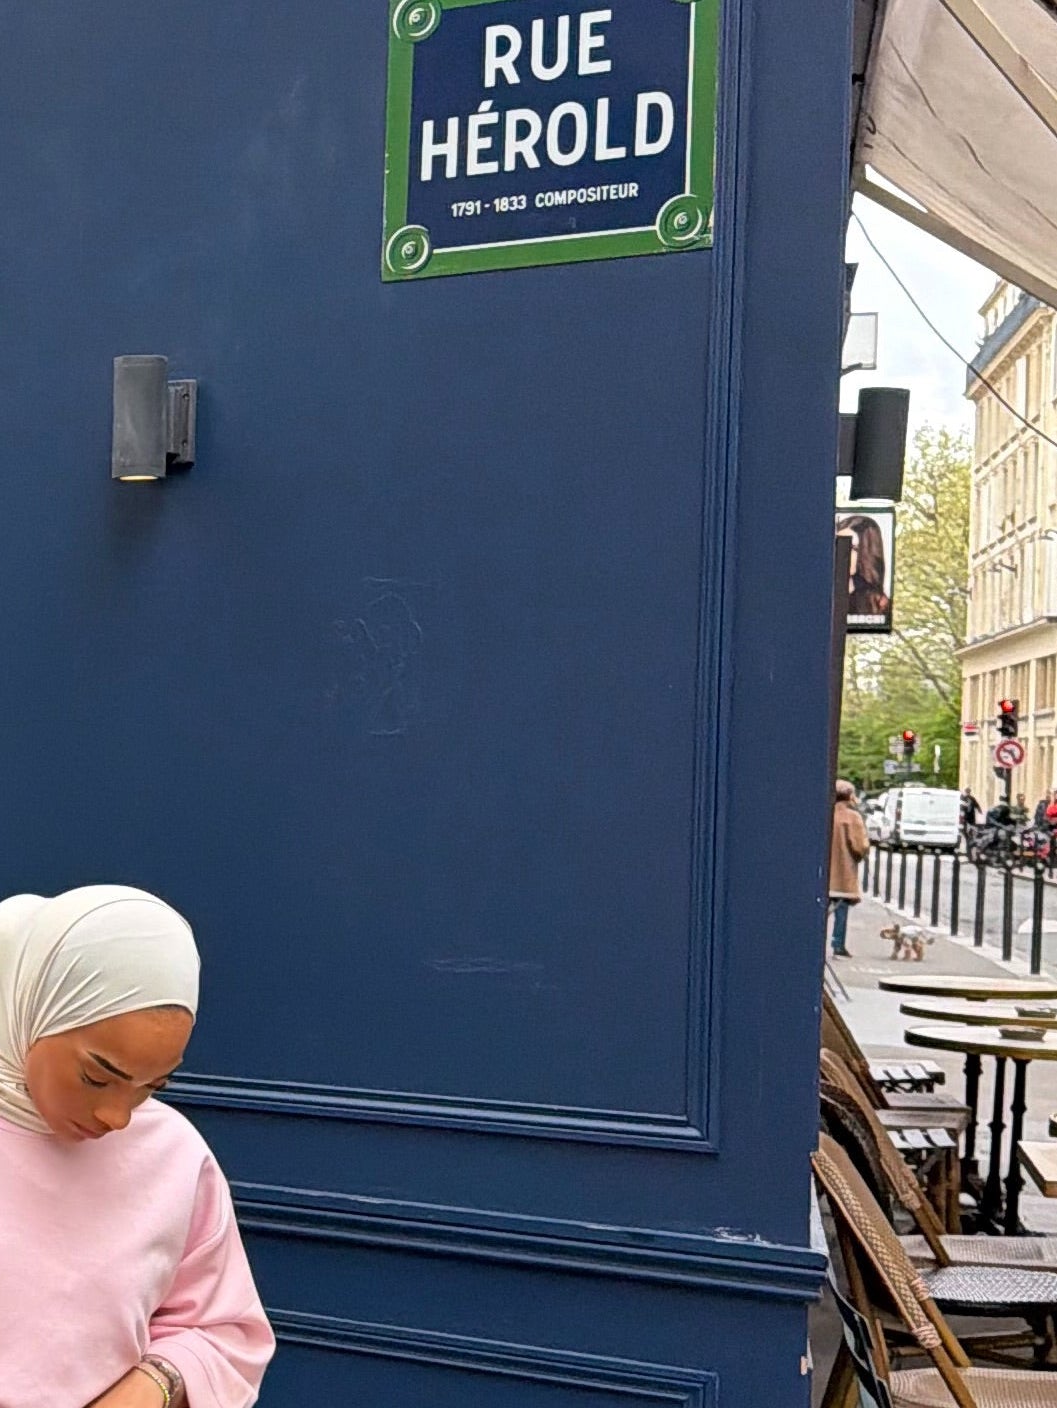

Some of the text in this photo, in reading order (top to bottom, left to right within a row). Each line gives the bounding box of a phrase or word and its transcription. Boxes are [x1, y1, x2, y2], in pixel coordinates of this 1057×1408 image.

[484, 9, 612, 88] RUE
[420, 91, 674, 182] HÉROLD
[451, 200, 481, 217] 1791
[493, 195, 527, 212] 1833
[534, 182, 640, 208] COMPOSITEUR
